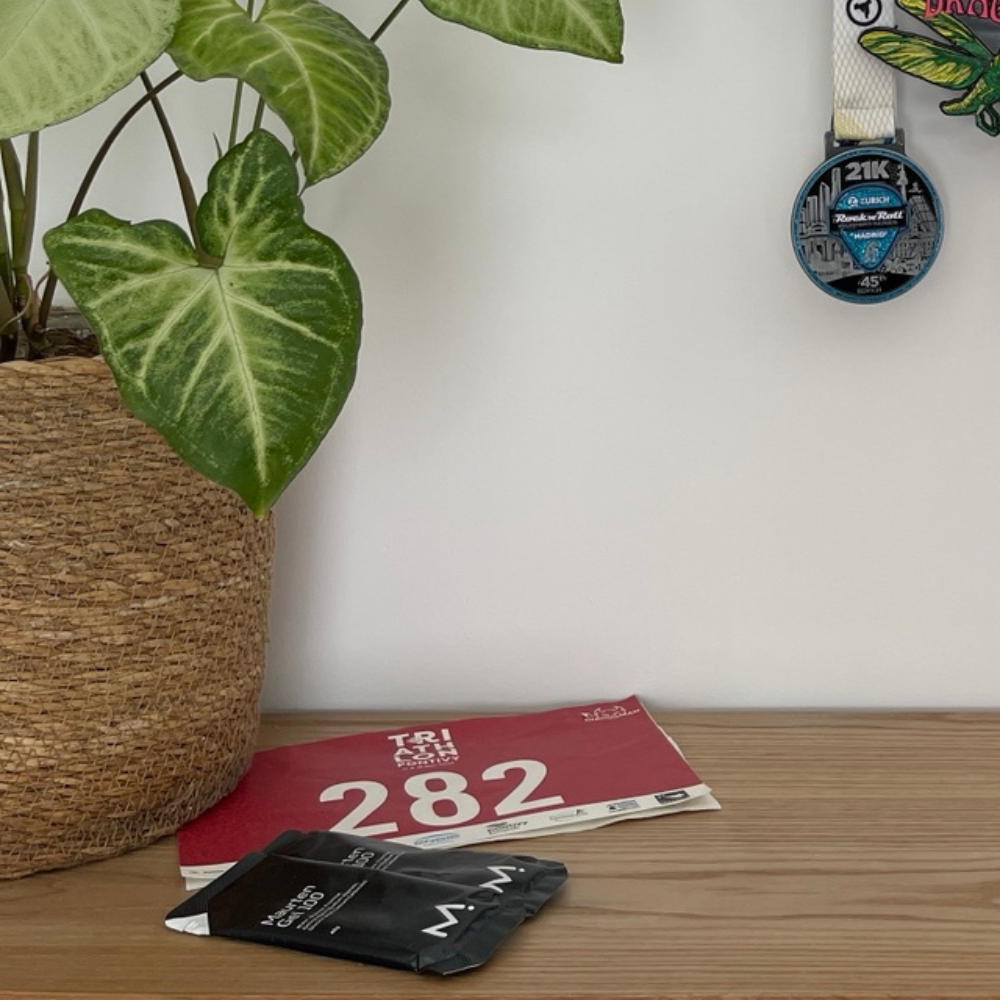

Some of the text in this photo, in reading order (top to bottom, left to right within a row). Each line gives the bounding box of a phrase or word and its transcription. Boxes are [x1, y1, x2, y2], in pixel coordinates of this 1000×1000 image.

[845, 159, 890, 181] 21K
[387, 728, 452, 747] TRI
[318, 758, 565, 837] 282
[260, 885, 317, 926] Maurten
[297, 891, 325, 911] 100
